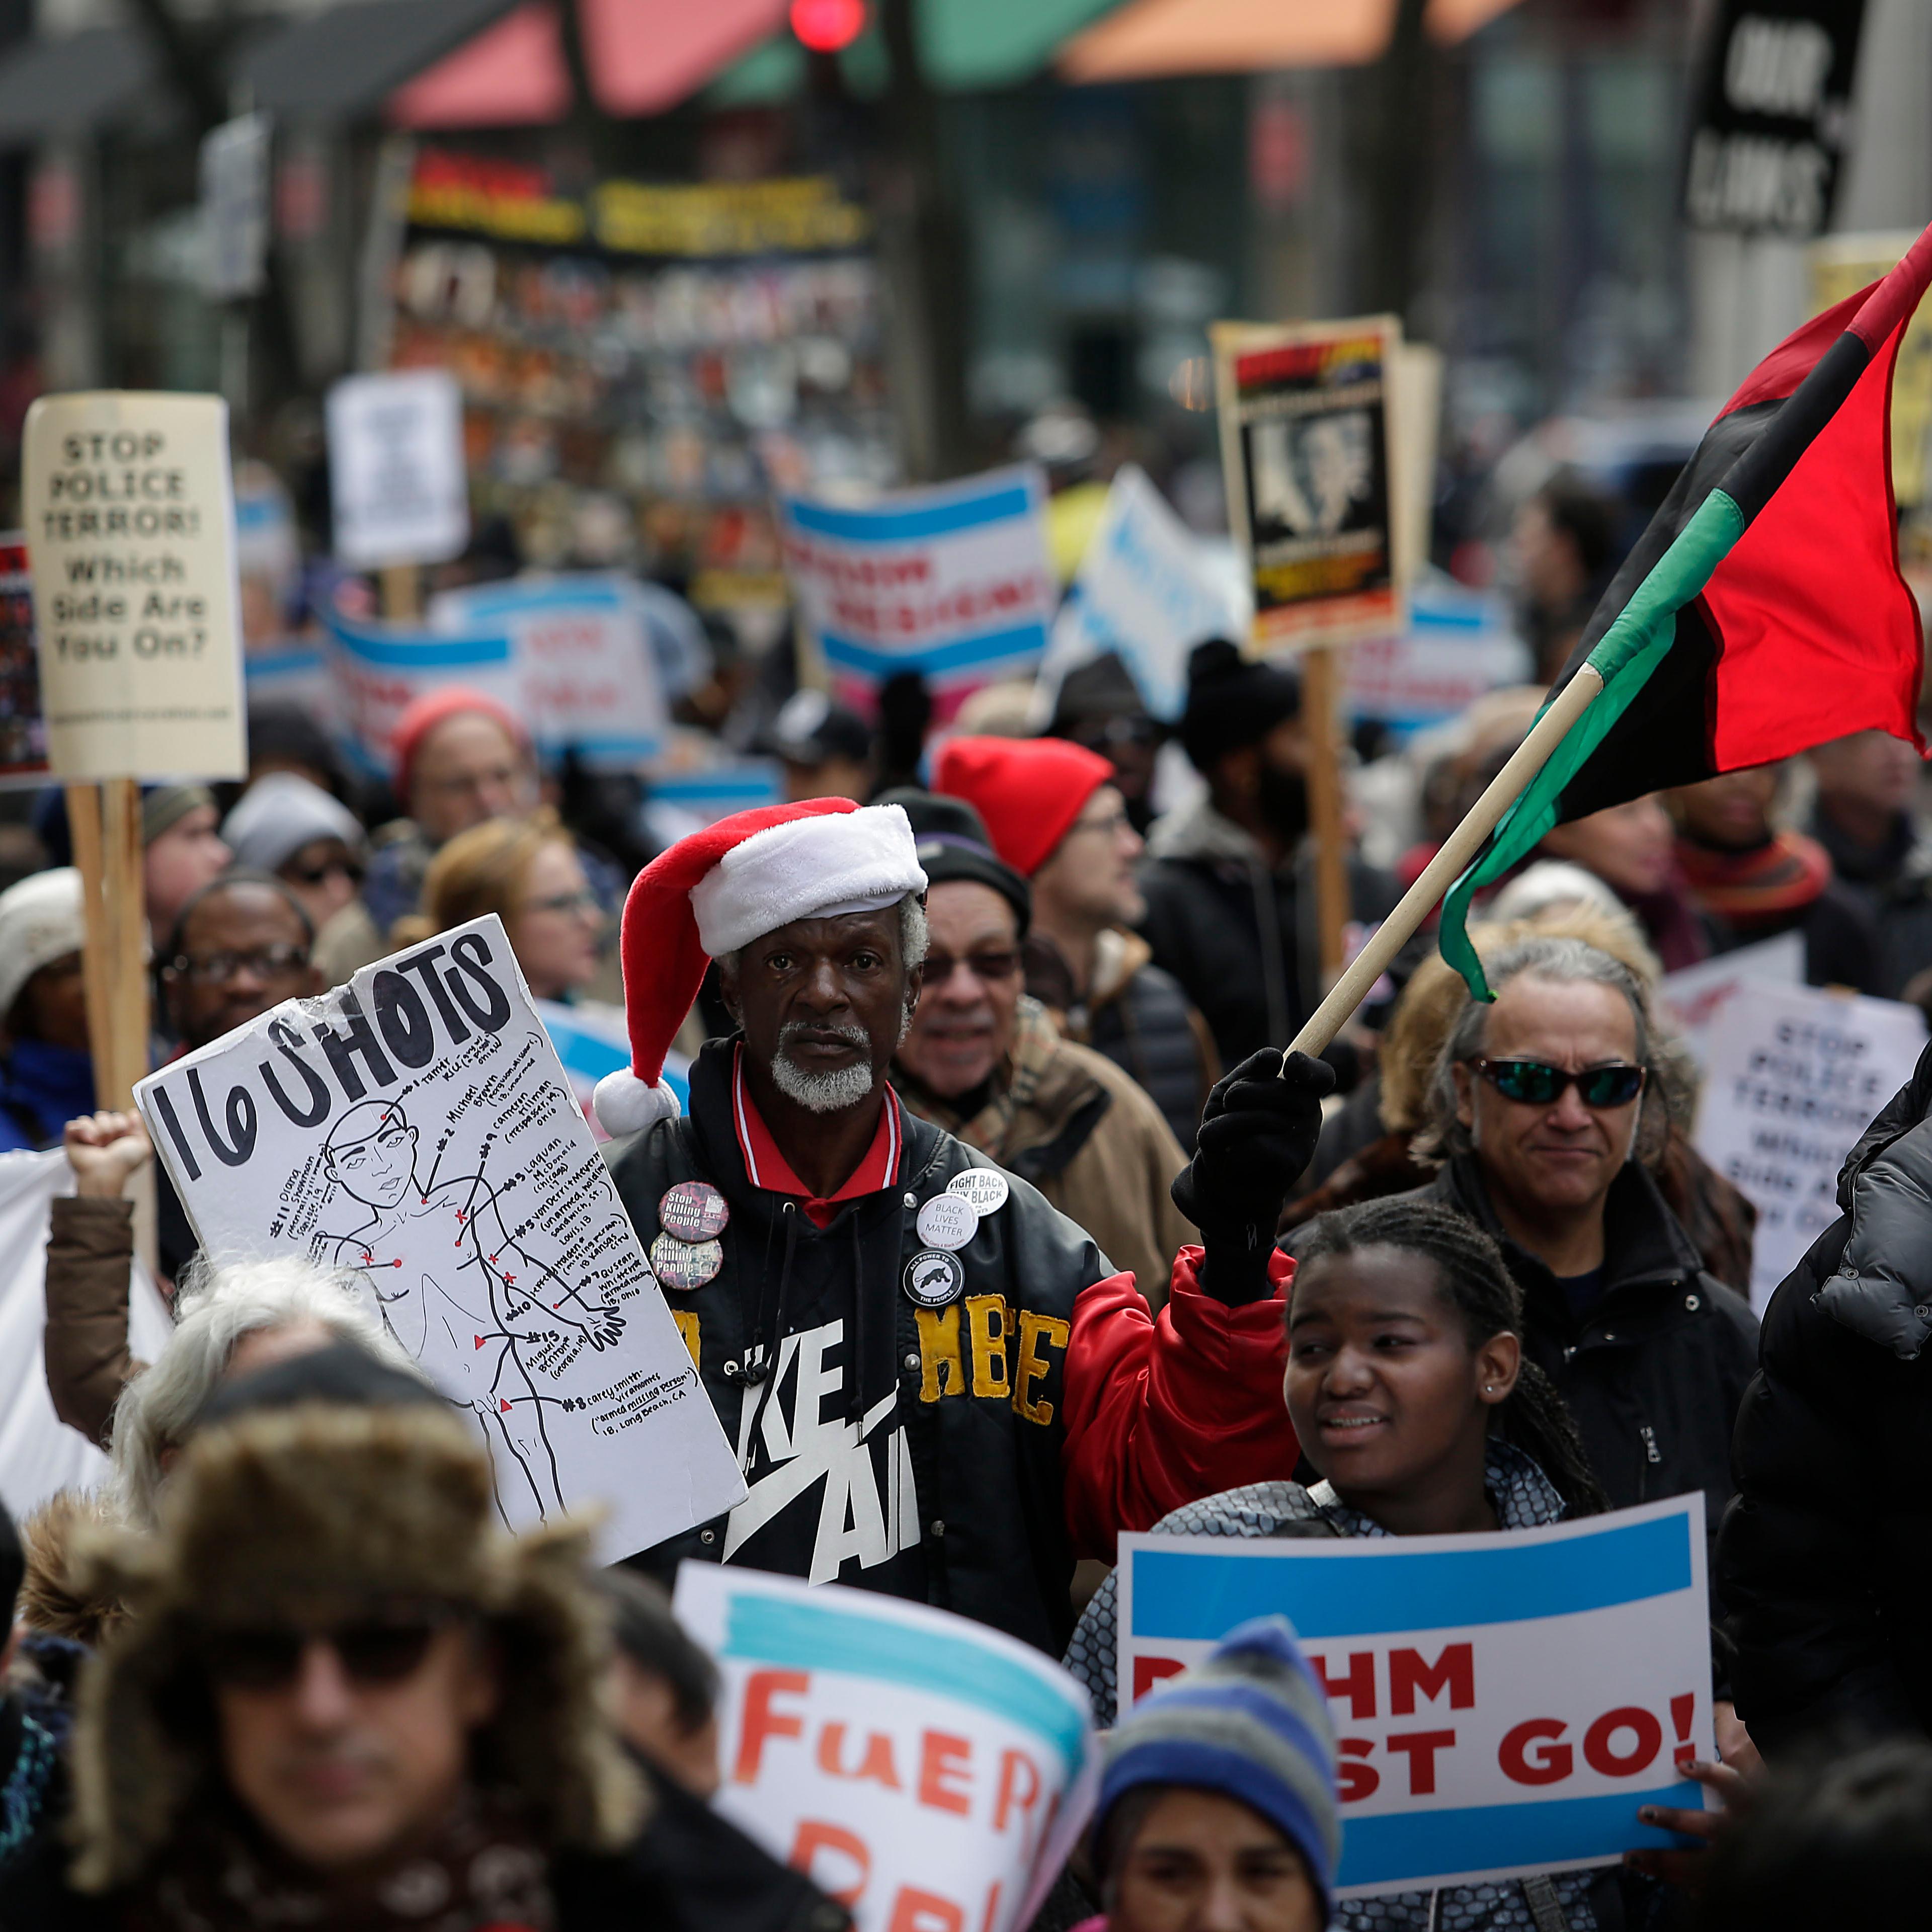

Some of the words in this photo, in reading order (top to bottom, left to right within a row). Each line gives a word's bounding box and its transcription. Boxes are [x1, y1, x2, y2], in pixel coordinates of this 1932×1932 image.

[62, 431, 165, 462] STOP
[49, 468, 186, 501] POLICE
[42, 509, 201, 540] TERROR!
[64, 553, 184, 586] Which
[52, 592, 127, 623] Side
[141, 592, 207, 620] Are
[53, 635, 118, 660] You
[132, 627, 208, 660] On?
[1777, 1019, 1867, 1057] STOP
[152, 1067, 257, 1181] 16
[259, 933, 512, 1128] SHOTS
[1752, 1049, 1881, 1098] POLICE
[473, 1074, 498, 1107] Brown
[446, 1084, 479, 1124] Michael
[950, 1175, 977, 1189] FIGHT
[979, 1175, 1004, 1188] BACK
[668, 1192, 692, 1205] Stop
[972, 1190, 1002, 1204] BLACK
[665, 1202, 701, 1217] Killing
[935, 1203, 964, 1216] BLACK
[663, 1213, 701, 1228] People
[934, 1214, 959, 1225] LIVES
[925, 1223, 963, 1237] MATTER
[657, 1239, 682, 1250] Stop
[656, 1249, 692, 1262] Killing
[910, 1261, 919, 1271] ALL
[919, 1253, 941, 1262] POWER
[656, 1261, 694, 1273] People
[932, 1289, 954, 1303] PEOPLE
[672, 1390, 687, 1401] CA
[1497, 1691, 1697, 1787] GO!
